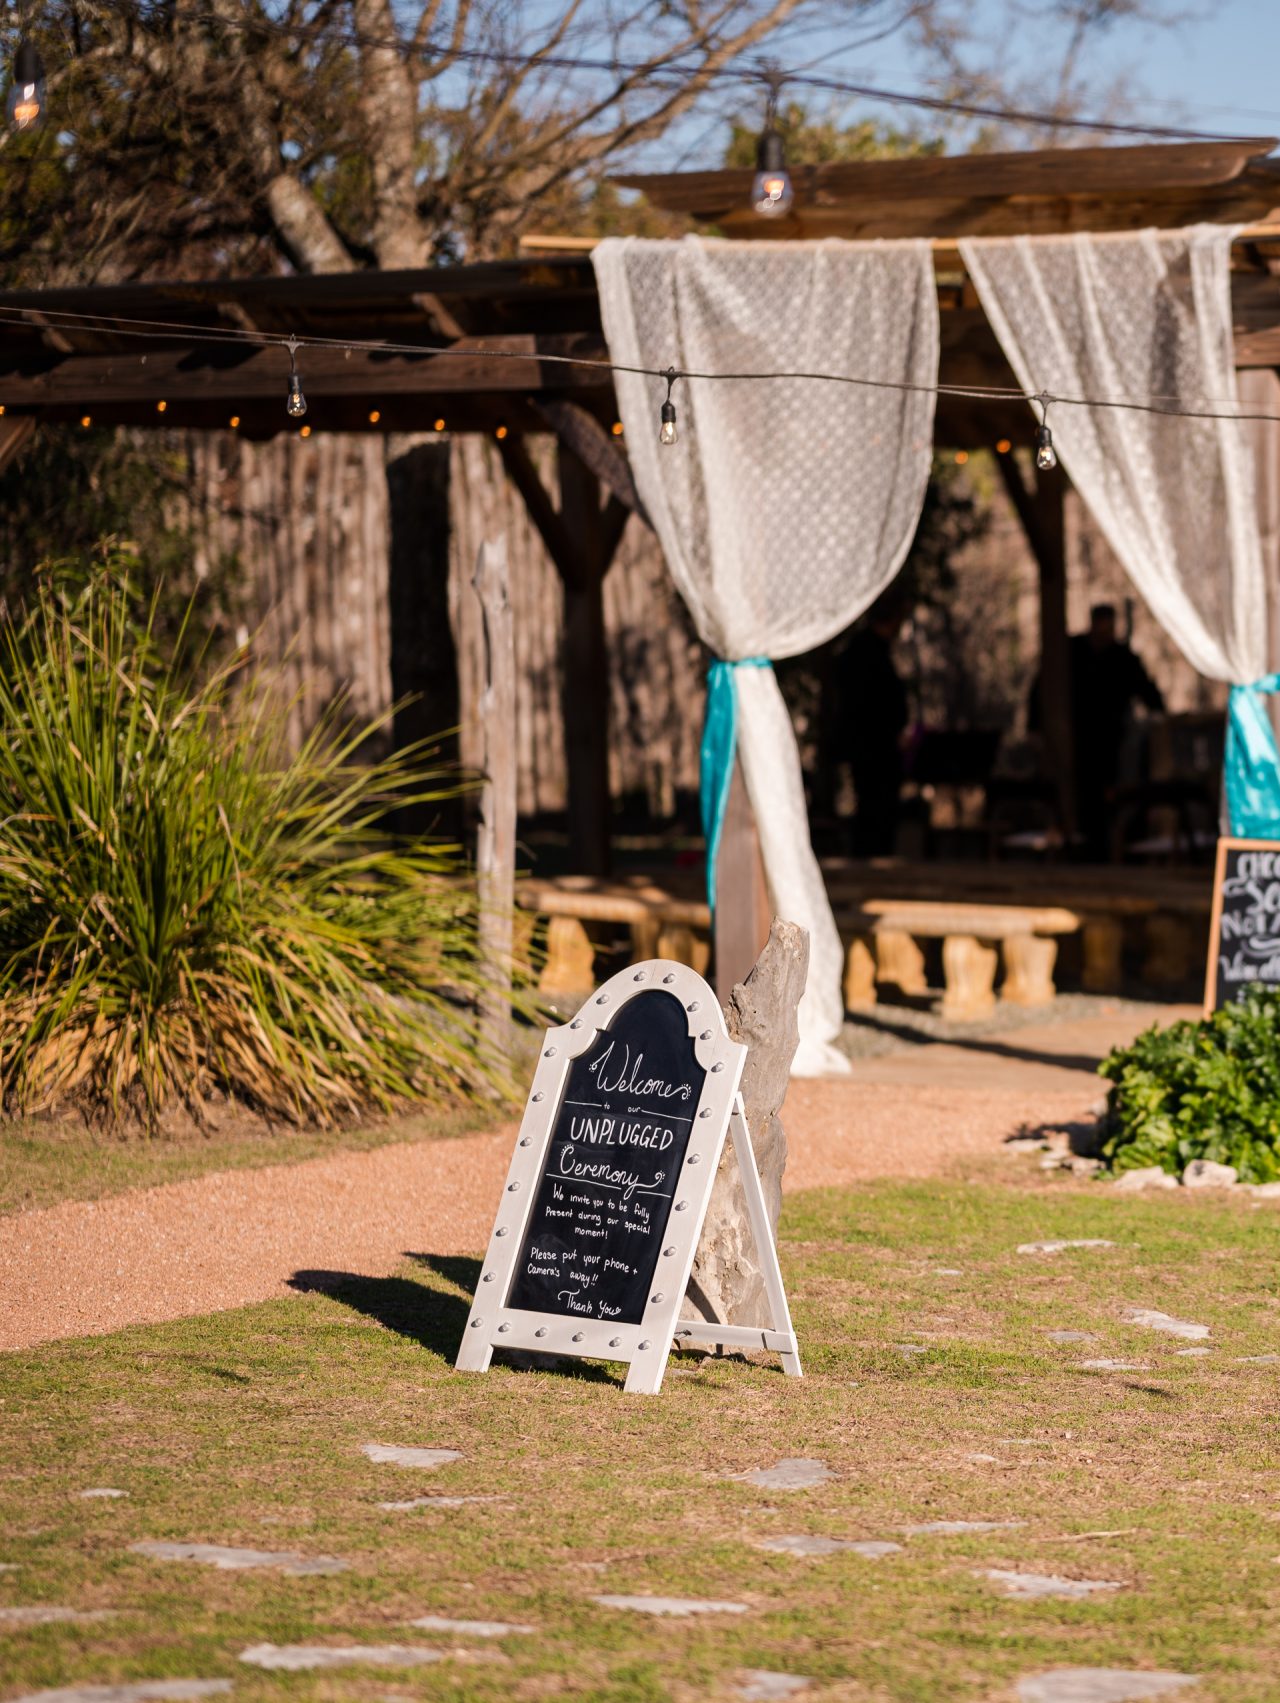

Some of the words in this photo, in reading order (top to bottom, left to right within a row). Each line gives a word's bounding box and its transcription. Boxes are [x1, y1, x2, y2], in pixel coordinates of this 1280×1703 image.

[589, 1041, 691, 1100] Welcome
[604, 1101, 610, 1110] to
[571, 1116, 674, 1151] UNPLUGGED
[560, 1145, 664, 1200] Ceremony
[553, 1183, 564, 1200] We
[570, 1194, 590, 1205] invite
[593, 1199, 604, 1208] you
[608, 1198, 616, 1210] to
[619, 1201, 628, 1212] be
[634, 1203, 650, 1224] fully
[574, 1226, 608, 1239] moment!
[578, 1211, 601, 1226] during
[606, 1217, 620, 1226] our
[624, 1221, 651, 1235] special
[531, 1247, 557, 1260] Please
[562, 1249, 577, 1263] put
[583, 1255, 601, 1266] your
[604, 1259, 630, 1274] phone
[558, 1289, 593, 1314] Thank
